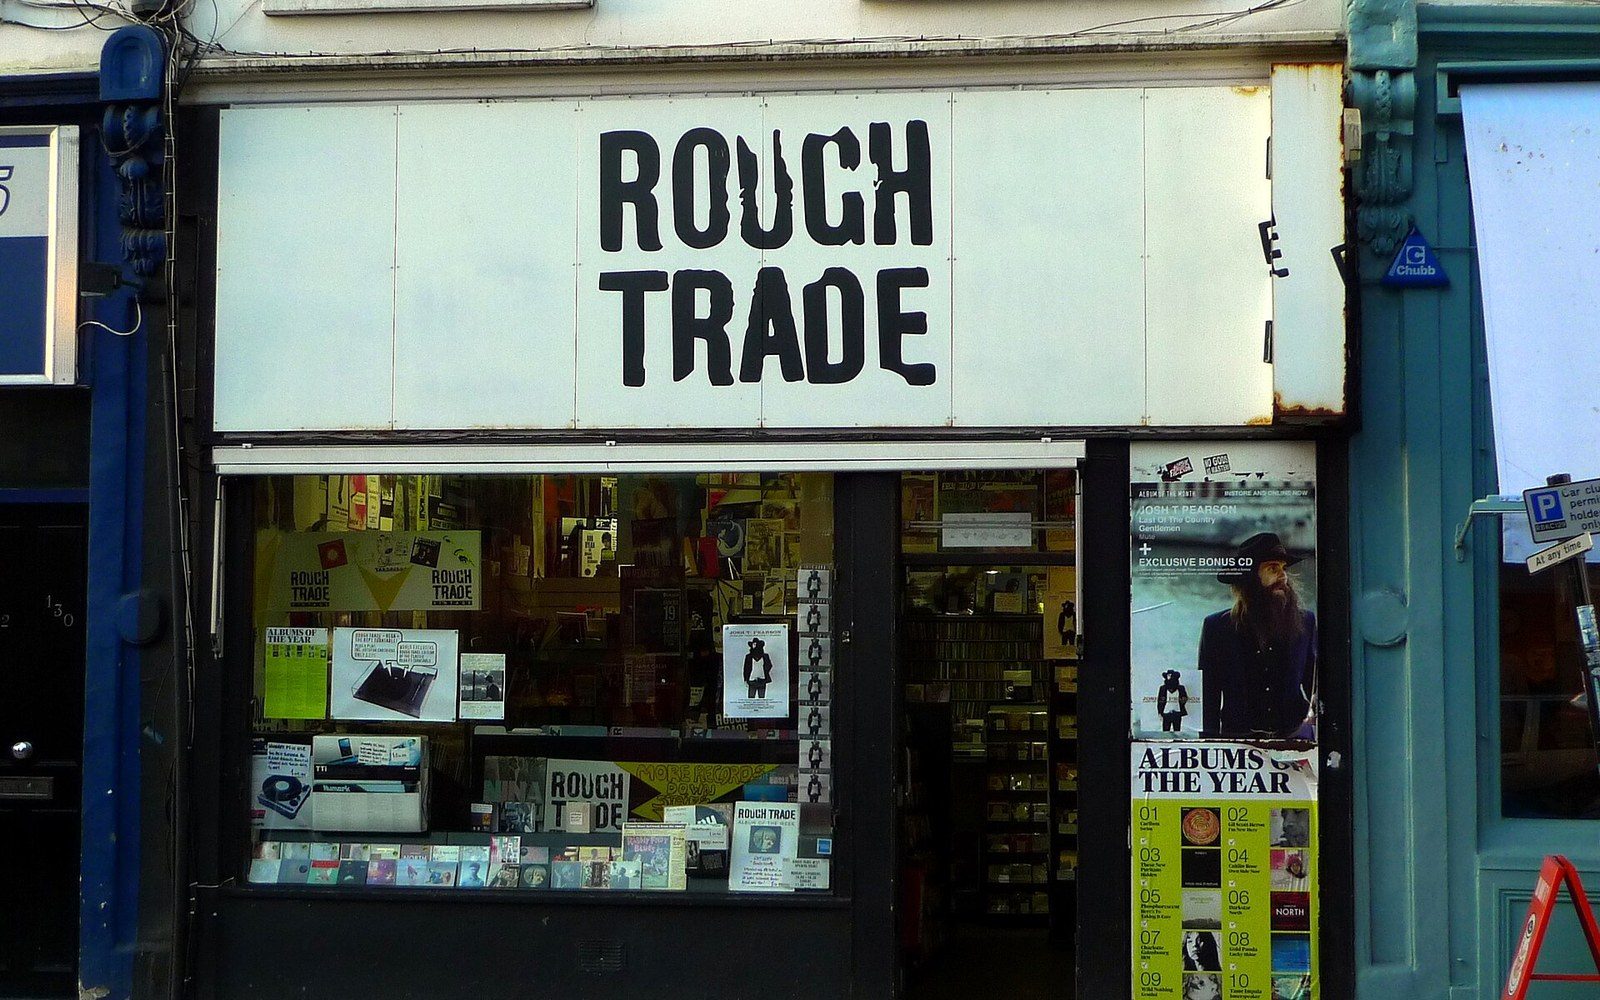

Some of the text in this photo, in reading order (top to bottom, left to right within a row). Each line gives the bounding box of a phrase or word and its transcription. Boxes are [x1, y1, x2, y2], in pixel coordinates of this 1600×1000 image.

[600, 120, 933, 252] ROUGH
[1396, 266, 1436, 275] Chubb
[599, 266, 936, 387] TRADE
[1562, 487, 1580, 497] Car
[1139, 504, 1237, 515] JOSH T PEARSON
[1538, 494, 1556, 520] P
[1185, 516, 1216, 525] Country
[1536, 540, 1582, 566] At any time
[1139, 558, 1253, 567] EXCLUSIVE BONUS CD
[290, 570, 330, 585] ROUGH
[432, 569, 472, 584] ROUGH
[291, 586, 330, 601] TRADE
[432, 585, 473, 599] TRADE
[48, 594, 74, 627] 130
[1139, 748, 1265, 770] ALBUMS
[636, 764, 765, 784] MORE RECORDS
[551, 771, 624, 799] ROUGH
[667, 782, 716, 796] DOWN
[1138, 772, 1292, 794] THE YEAR
[551, 801, 623, 830] TDE
[738, 809, 796, 820] ROUGH TRADE
[1140, 806, 1158, 820] 01
[1228, 807, 1248, 822] 02
[1140, 848, 1160, 862] 03
[1228, 848, 1248, 862] 04
[1140, 889, 1160, 903] 05
[1228, 890, 1249, 904] 06
[1276, 908, 1305, 916] NORTH
[1140, 930, 1160, 944] 07
[1229, 932, 1249, 946] 08
[1141, 972, 1161, 986] 09
[1230, 974, 1249, 988] 10
